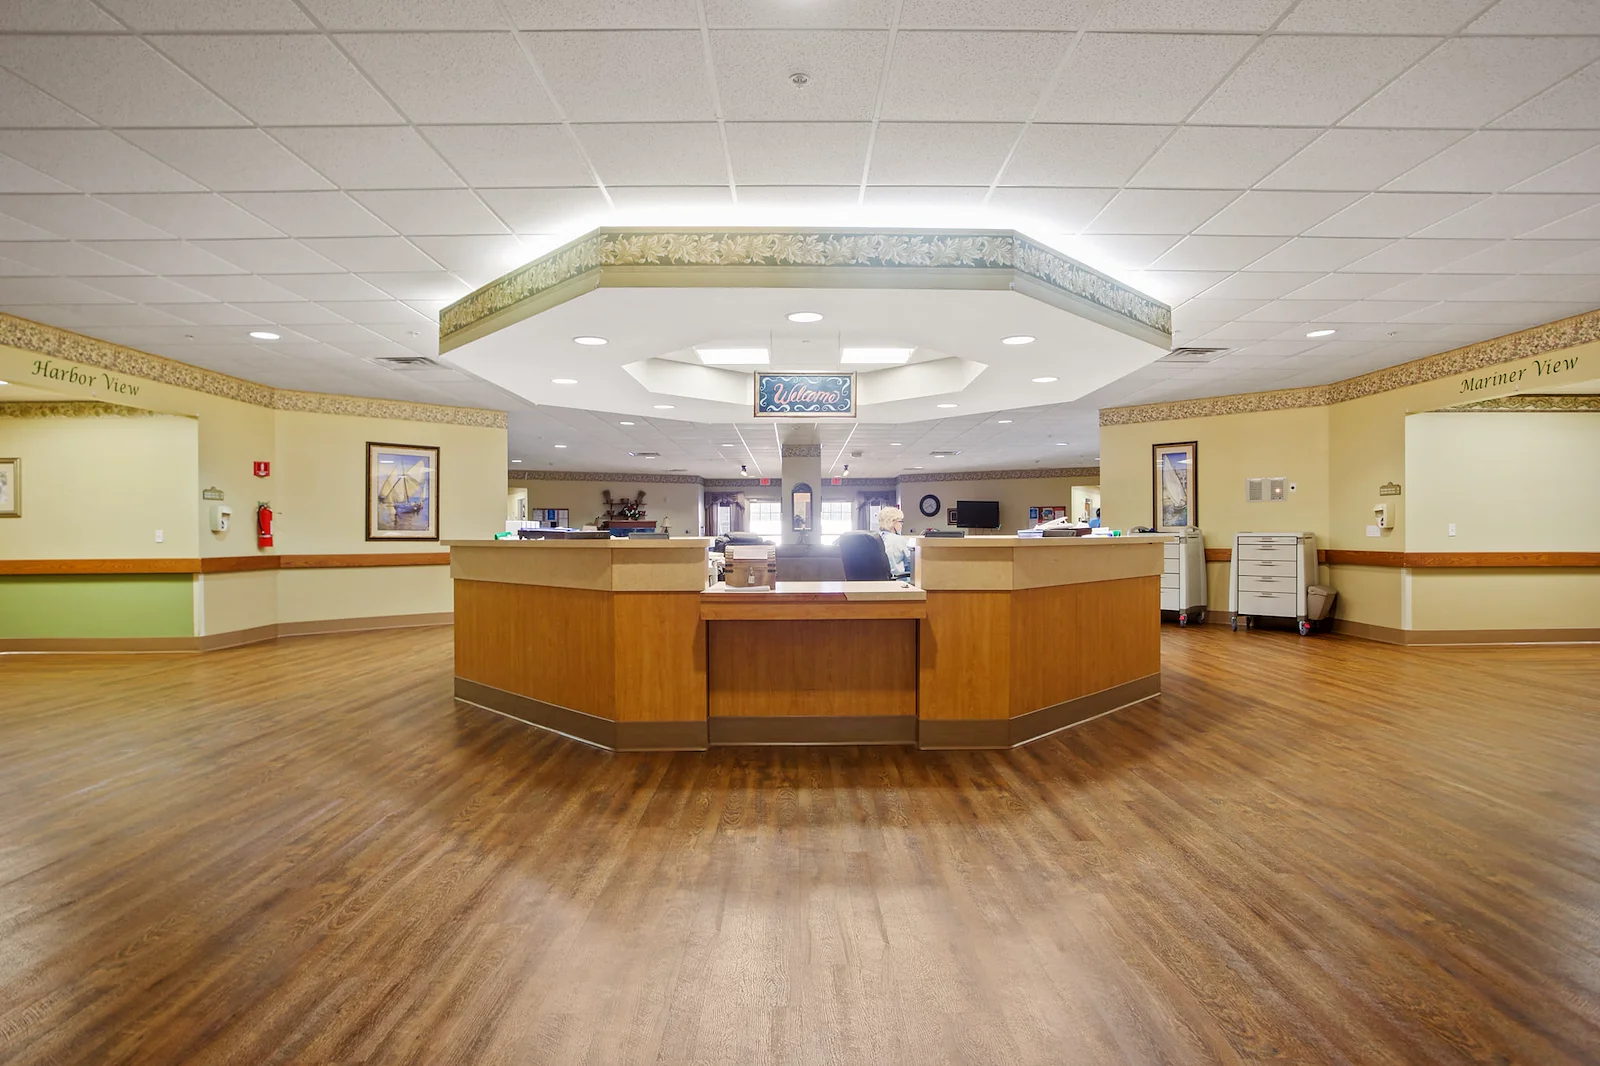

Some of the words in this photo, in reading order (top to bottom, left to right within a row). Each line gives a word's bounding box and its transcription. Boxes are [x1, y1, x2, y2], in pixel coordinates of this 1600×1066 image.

[31, 360, 97, 387] Harbor
[102, 373, 140, 396] View
[1459, 368, 1527, 394] Mariner
[1532, 357, 1579, 376] View
[773, 383, 840, 405] Welcome
